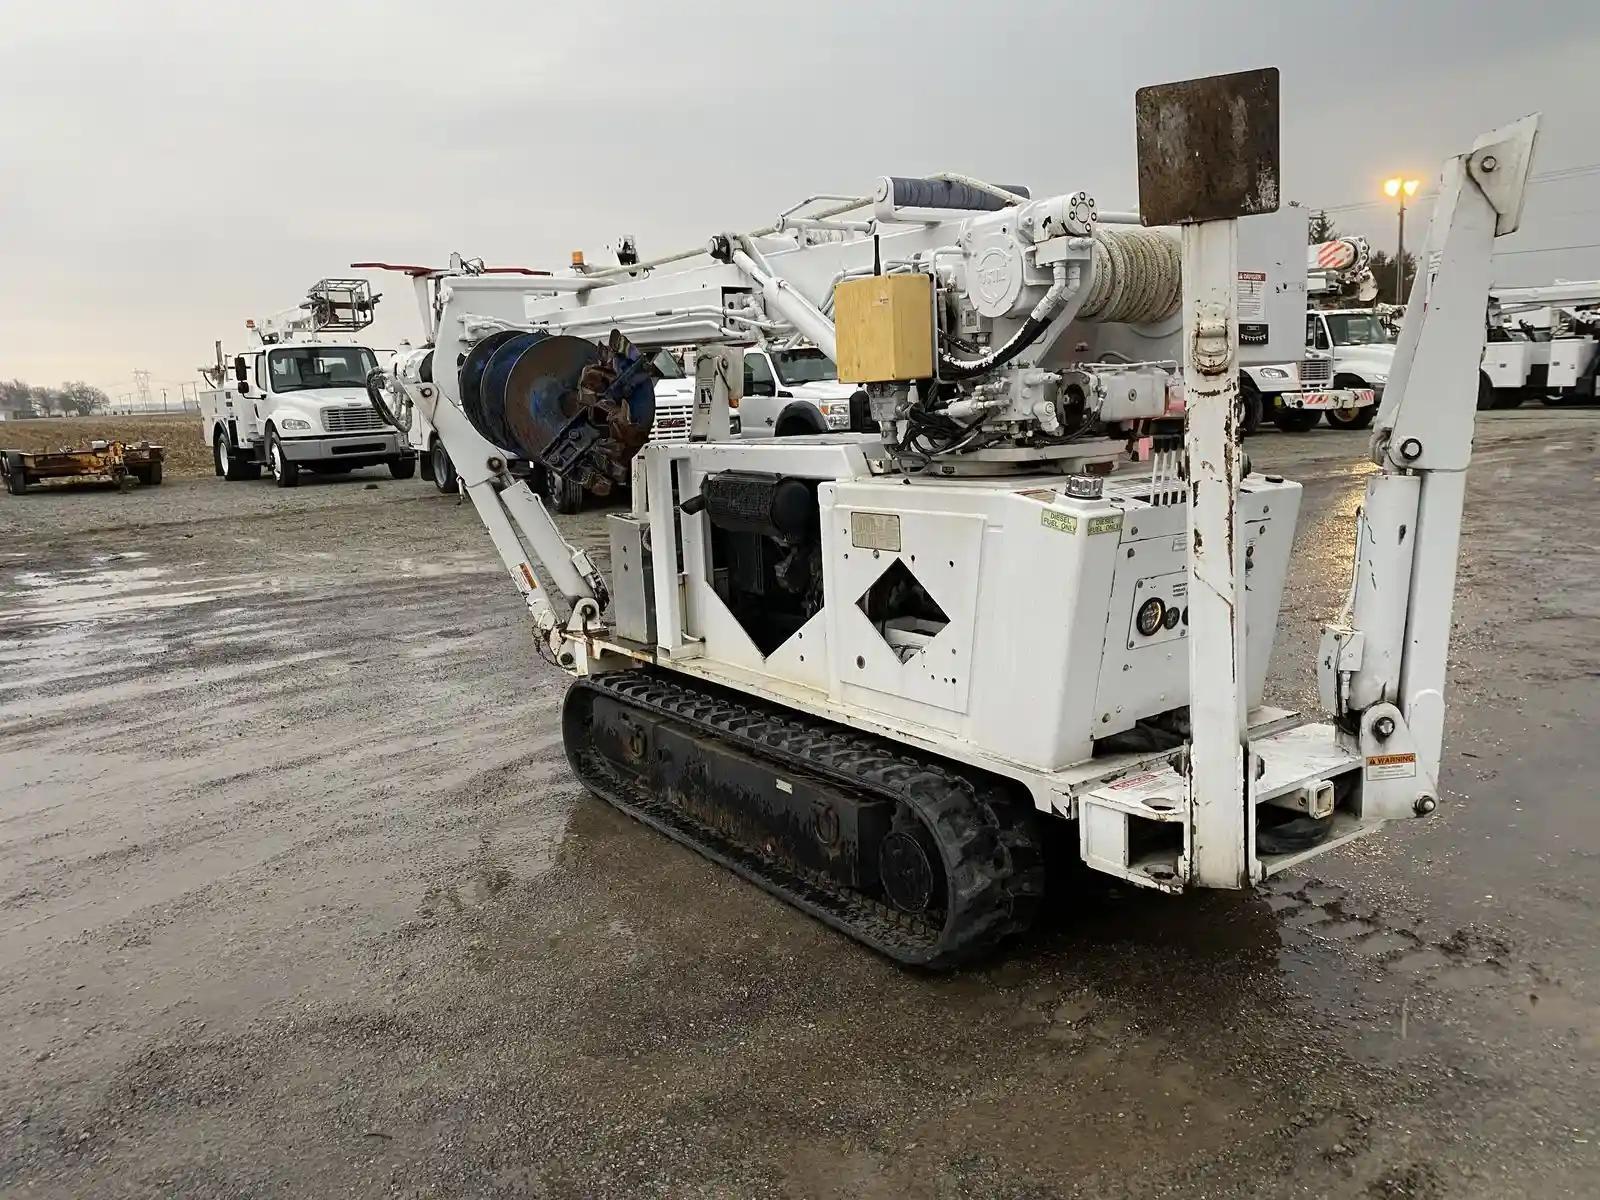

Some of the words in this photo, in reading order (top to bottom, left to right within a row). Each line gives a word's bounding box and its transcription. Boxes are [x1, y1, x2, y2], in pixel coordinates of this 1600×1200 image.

[1050, 512, 1072, 525] DIESEL
[1095, 516, 1115, 526] DIESEL
[1043, 517, 1059, 528] FUEL
[1061, 522, 1076, 533] ONLY
[1377, 755, 1414, 765] WARNING
